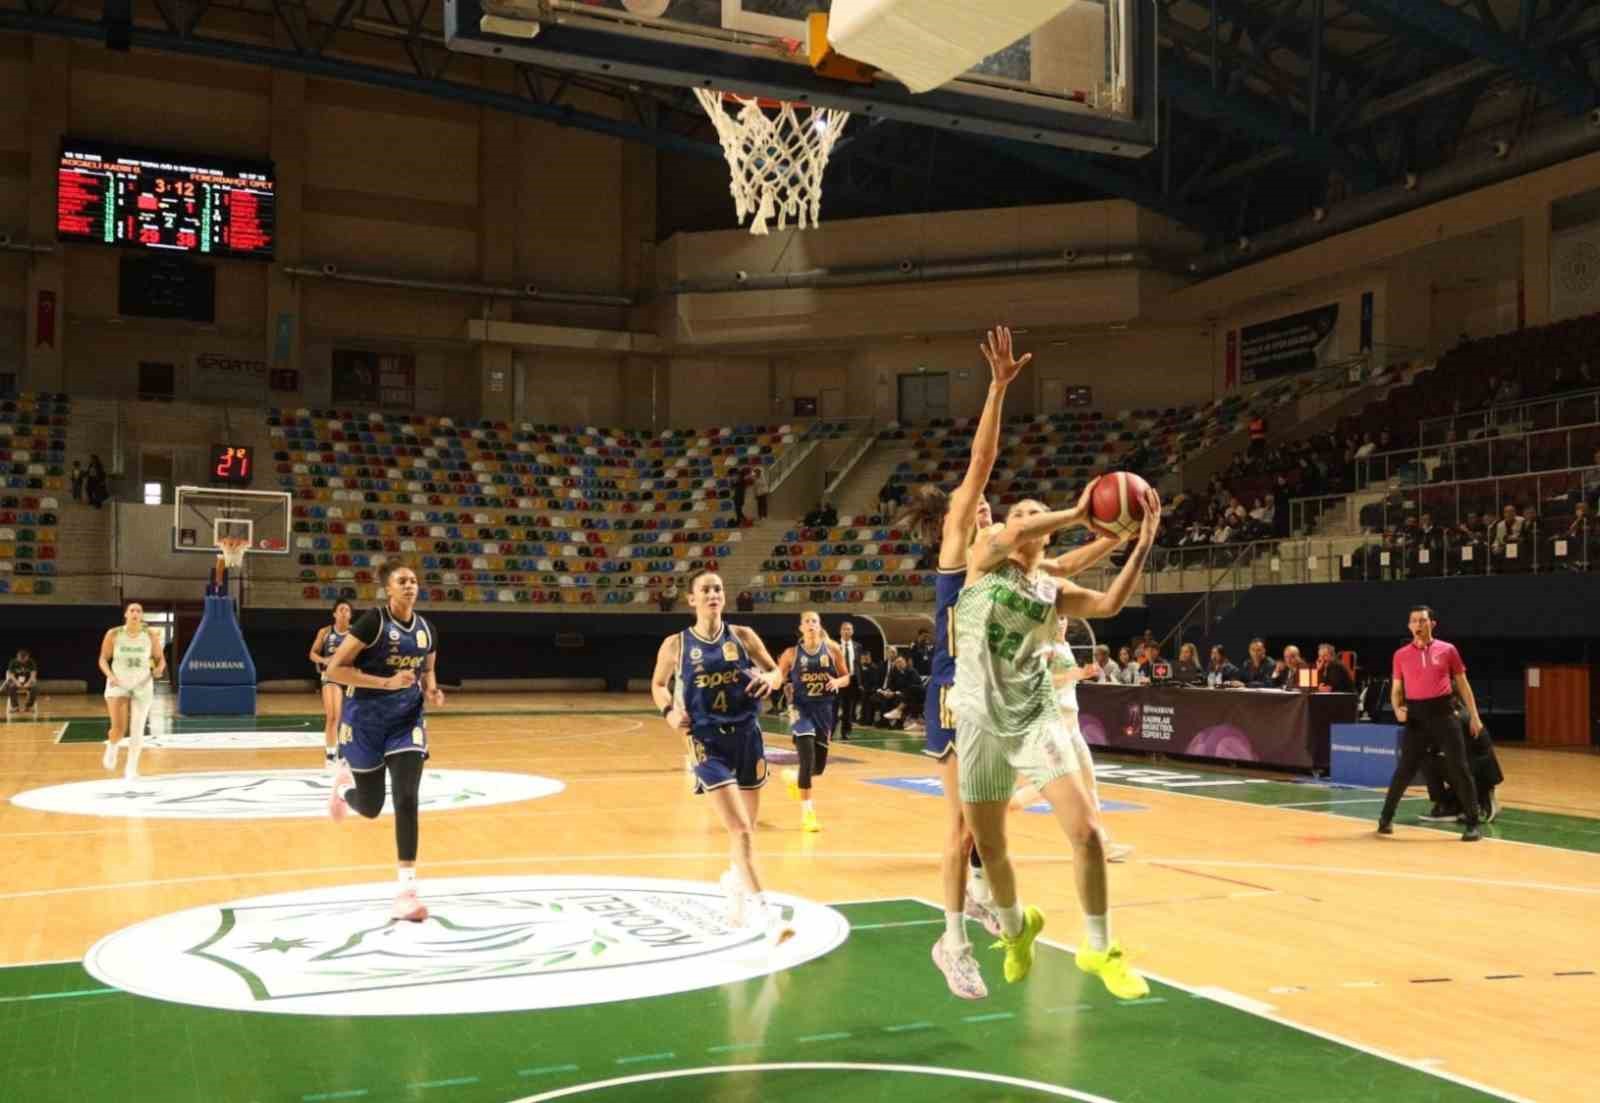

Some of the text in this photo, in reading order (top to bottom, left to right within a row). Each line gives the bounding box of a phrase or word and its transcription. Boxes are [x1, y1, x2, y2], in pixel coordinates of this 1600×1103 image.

[695, 668, 739, 688] opet
[807, 683, 824, 696] 22
[712, 690, 728, 712] 4
